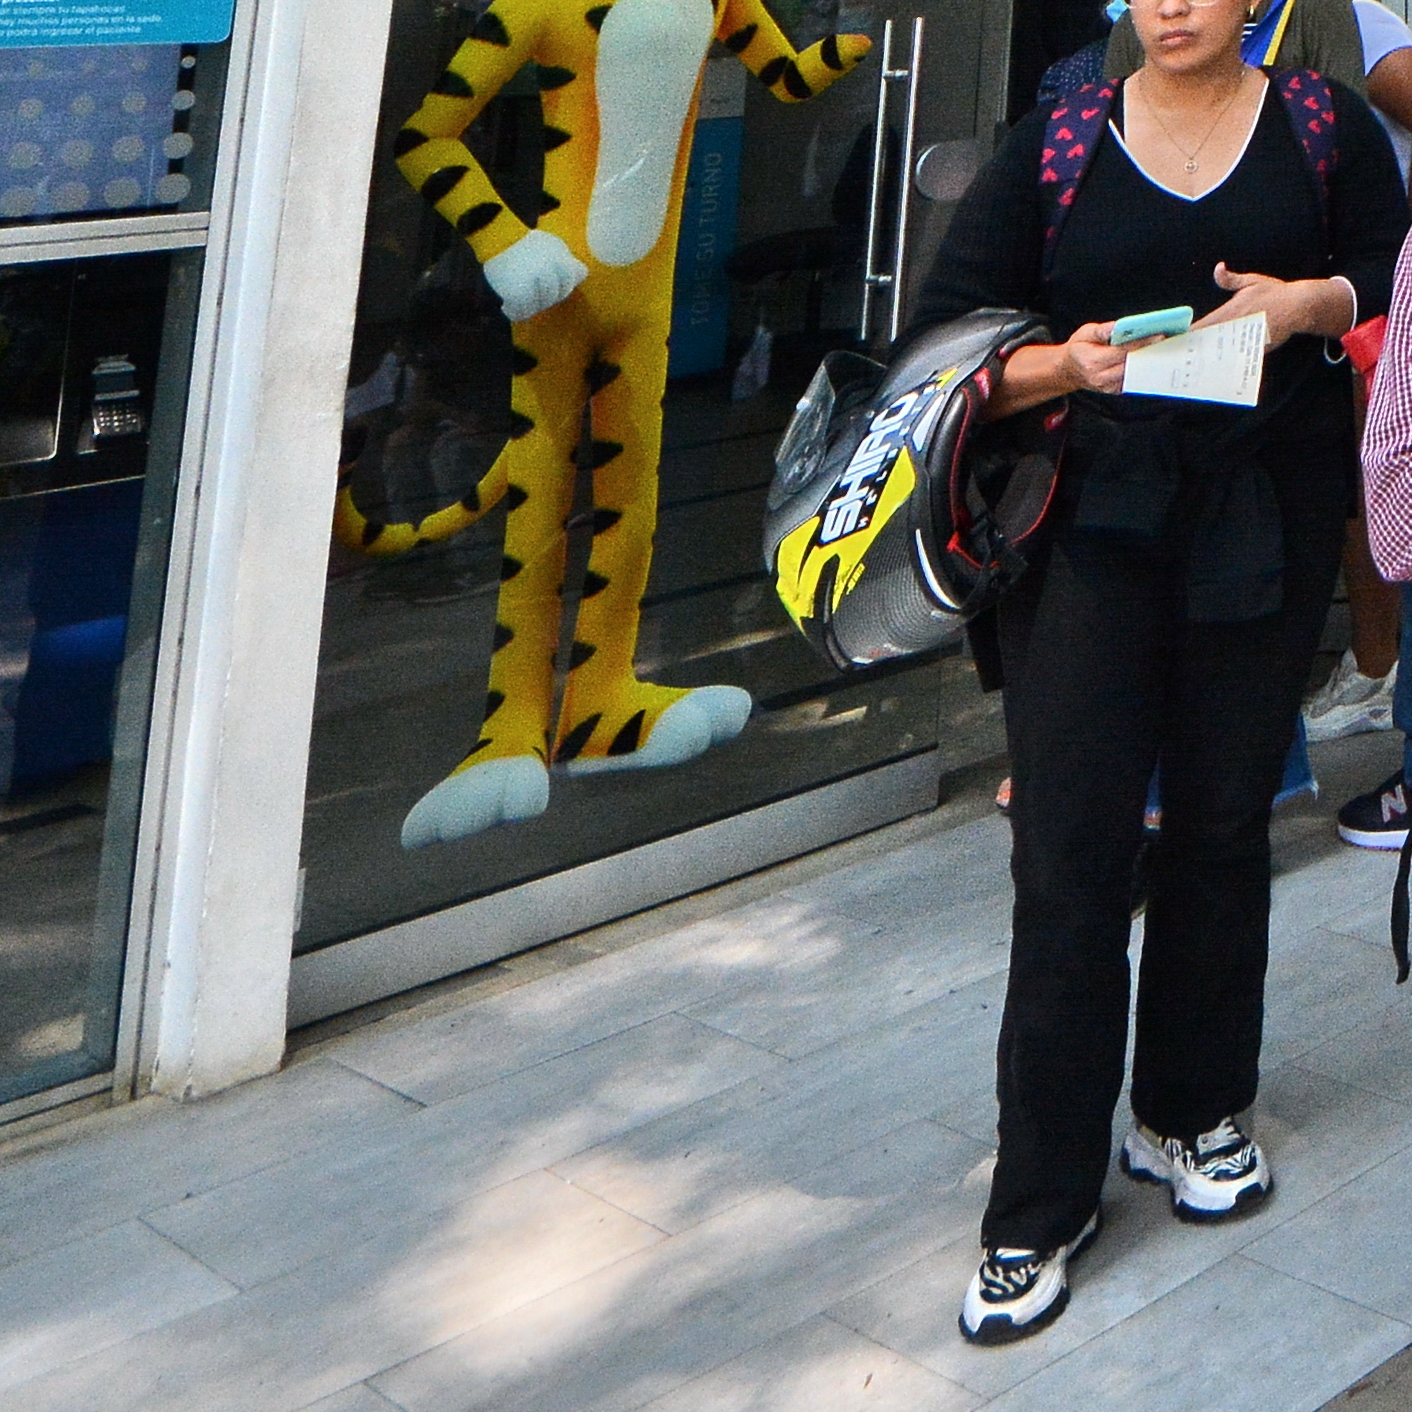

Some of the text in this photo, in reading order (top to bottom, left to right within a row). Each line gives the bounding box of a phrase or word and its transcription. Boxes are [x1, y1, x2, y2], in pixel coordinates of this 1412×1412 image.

[698, 152, 724, 227] TURNO
[696, 233, 718, 261] SU
[820, 391, 920, 544] SHIRO
